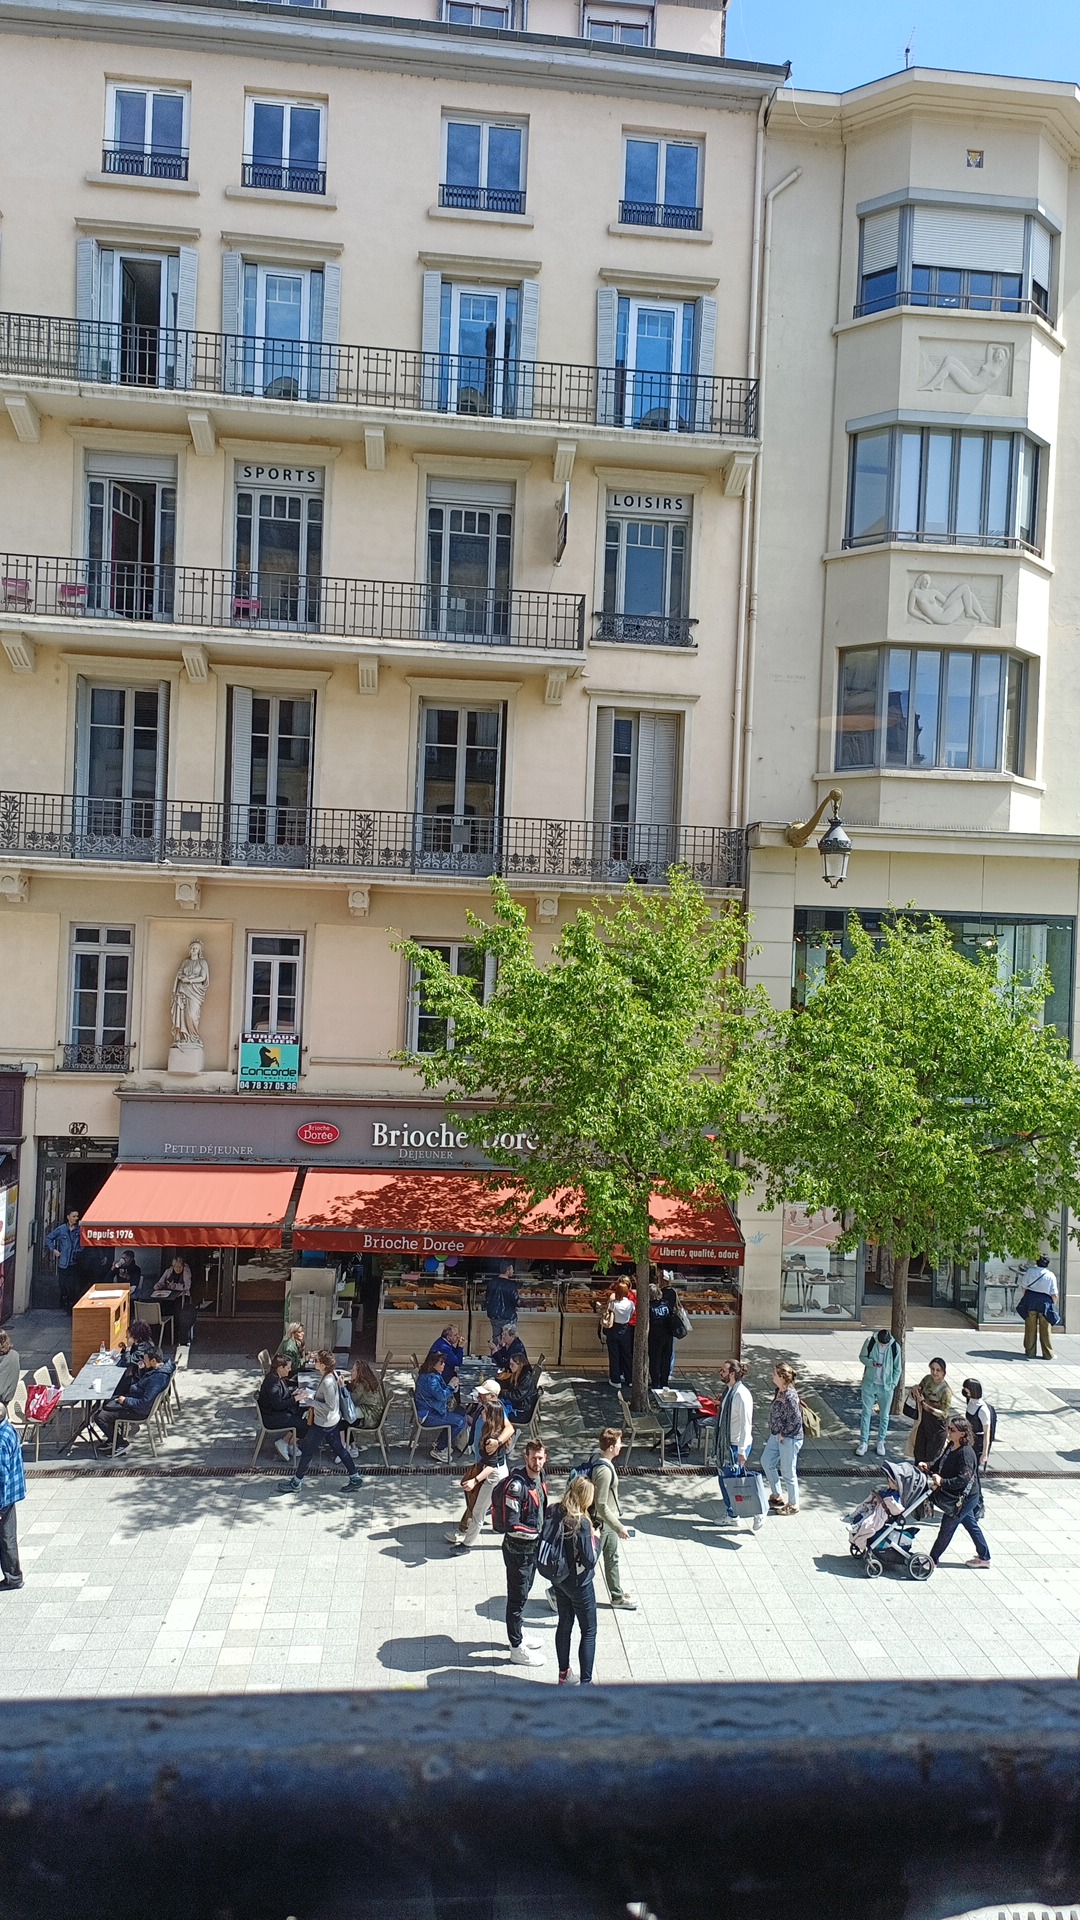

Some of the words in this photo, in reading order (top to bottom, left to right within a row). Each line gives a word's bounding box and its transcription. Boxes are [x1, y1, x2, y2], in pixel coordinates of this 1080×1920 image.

[243, 466, 316, 483] SPORTS
[613, 494, 683, 510] LOISIRS
[241, 1066, 297, 1076] Concorde
[240, 1081, 250, 1089] 04
[252, 1081, 262, 1089] 78
[70, 1121, 87, 1135] 87
[303, 1129, 333, 1140] Dorée
[371, 1122, 469, 1149] Brioche
[164, 1143, 197, 1154] PETIT
[199, 1144, 254, 1156] DÉJEUNER
[87, 1229, 115, 1240] Depuis
[116, 1229, 134, 1239] 1976
[363, 1234, 419, 1250] Brioche
[422, 1237, 465, 1252] Dorée
[659, 1247, 687, 1258] Liberté,
[689, 1248, 716, 1259] qualité,
[718, 1250, 740, 1259] adoré
